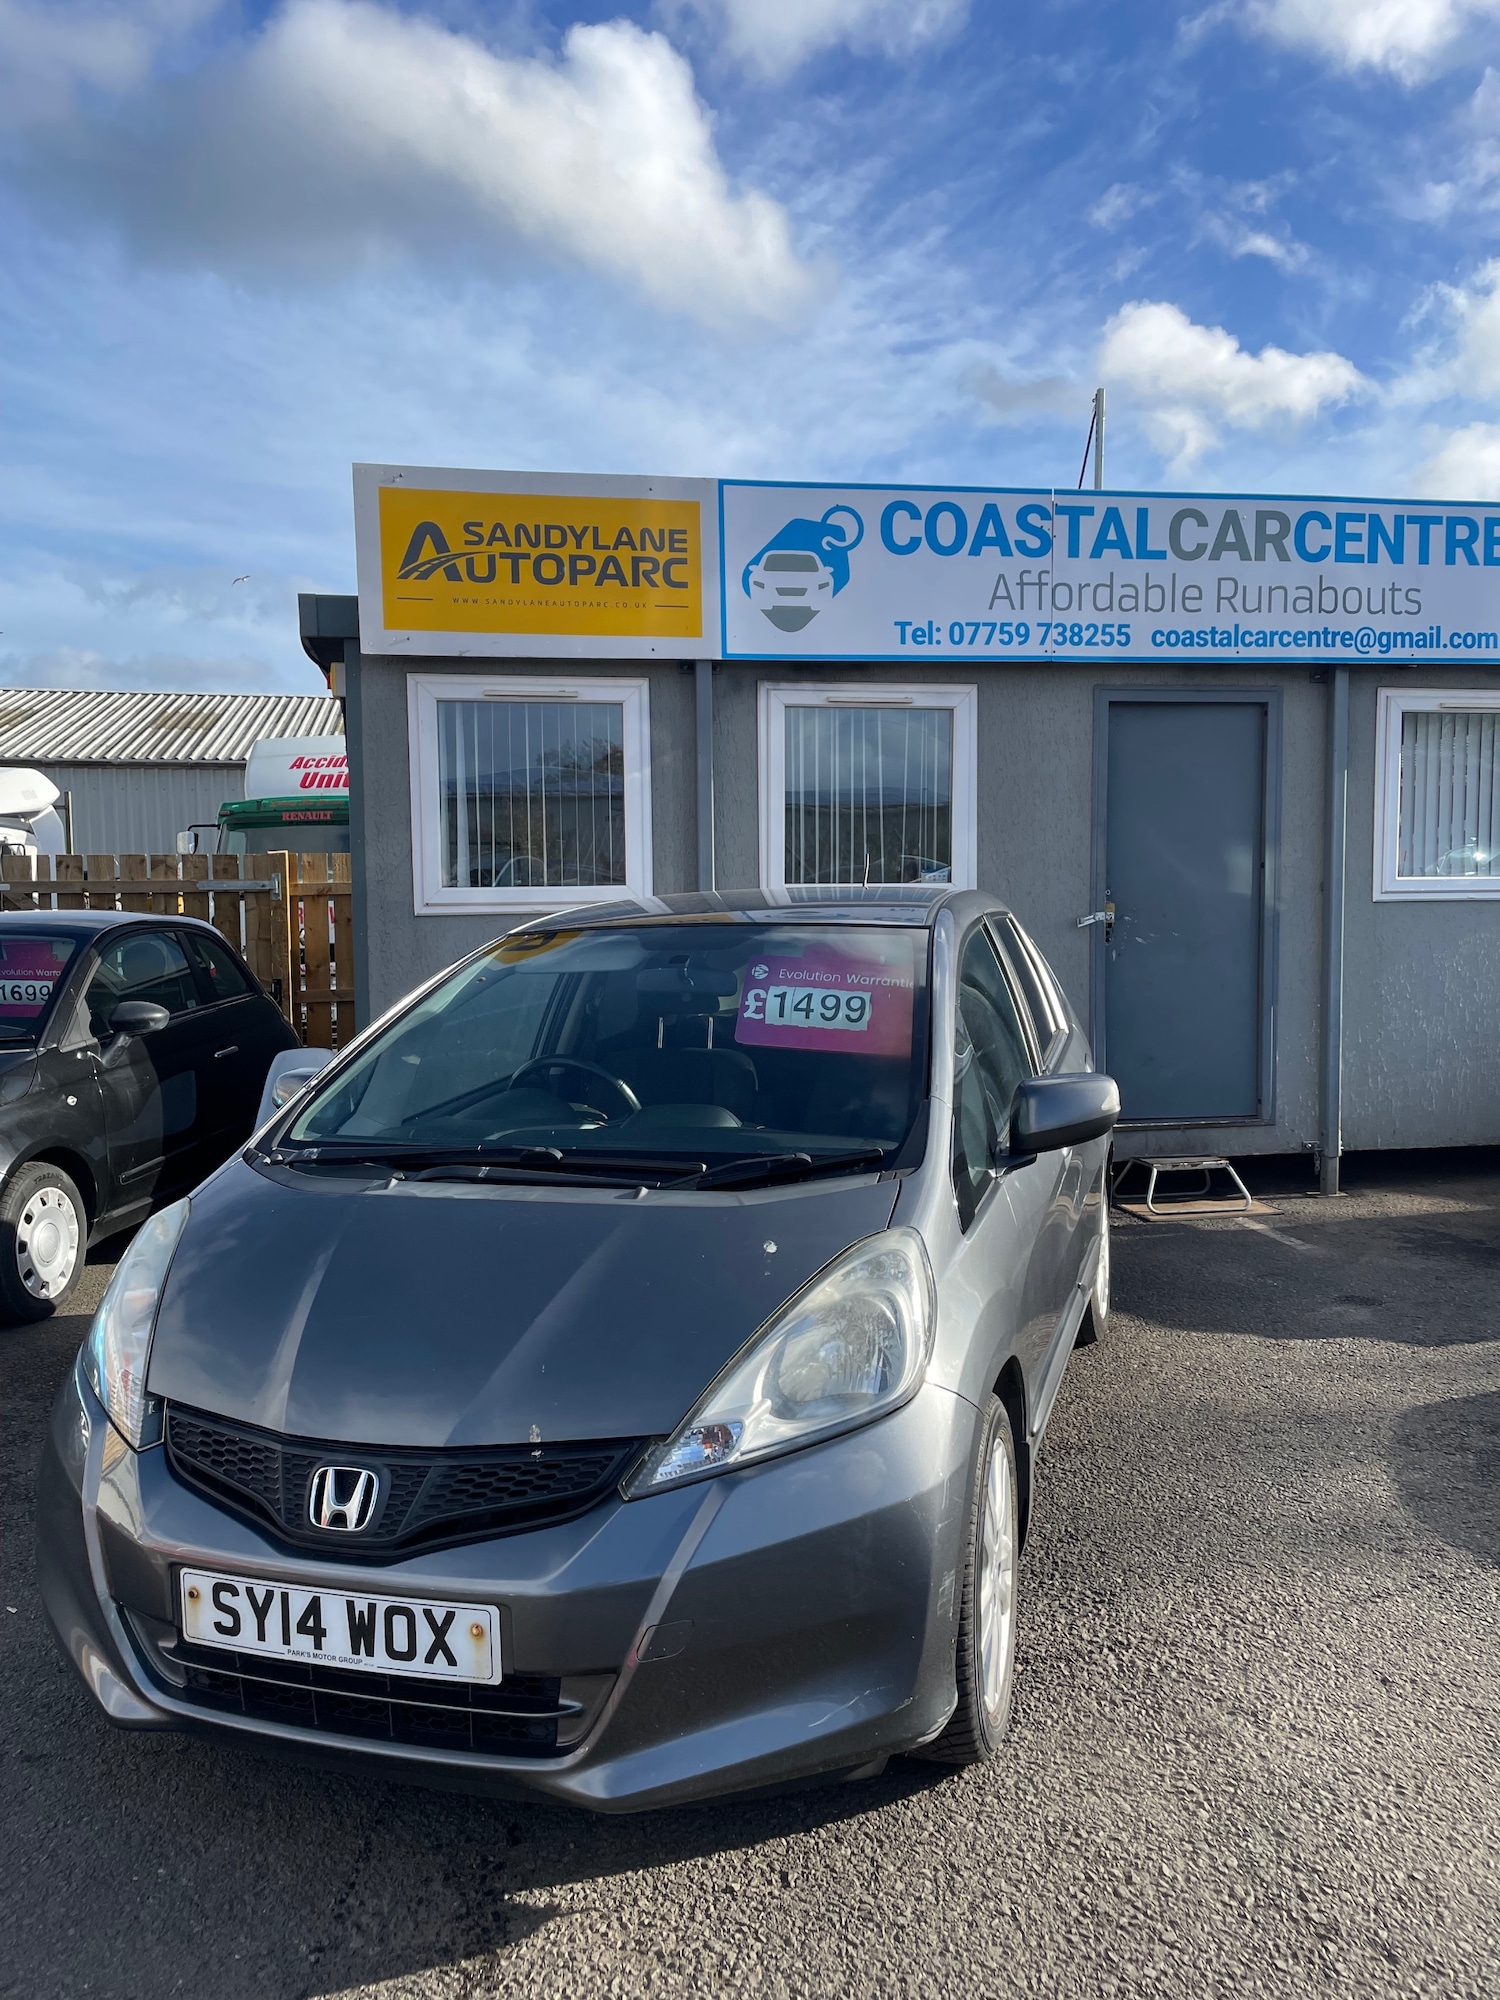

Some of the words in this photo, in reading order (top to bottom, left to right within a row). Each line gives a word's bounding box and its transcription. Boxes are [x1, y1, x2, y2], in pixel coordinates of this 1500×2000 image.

[462, 520, 688, 553] SANDYLANE
[397, 521, 689, 588] AUTOPARC
[988, 570, 1203, 613] Affordable
[1215, 574, 1422, 616] Runabouts
[894, 620, 942, 646] Tel:
[949, 621, 1030, 646] 07759
[1036, 622, 1131, 648] 738255
[1151, 624, 1498, 654] coastalcarcentre@gmail.com
[289, 755, 348, 769] Accid
[282, 810, 333, 821] RENAULT
[0, 968, 34, 976] volution
[778, 968, 841, 983] Evolution
[743, 988, 867, 1024] £1499
[212, 1581, 327, 1650] SY14
[345, 1599, 458, 1667] WOX
[287, 1649, 311, 1658] PARK'S
[312, 1652, 337, 1661] MOTOR
[338, 1656, 363, 1665] GROUP
